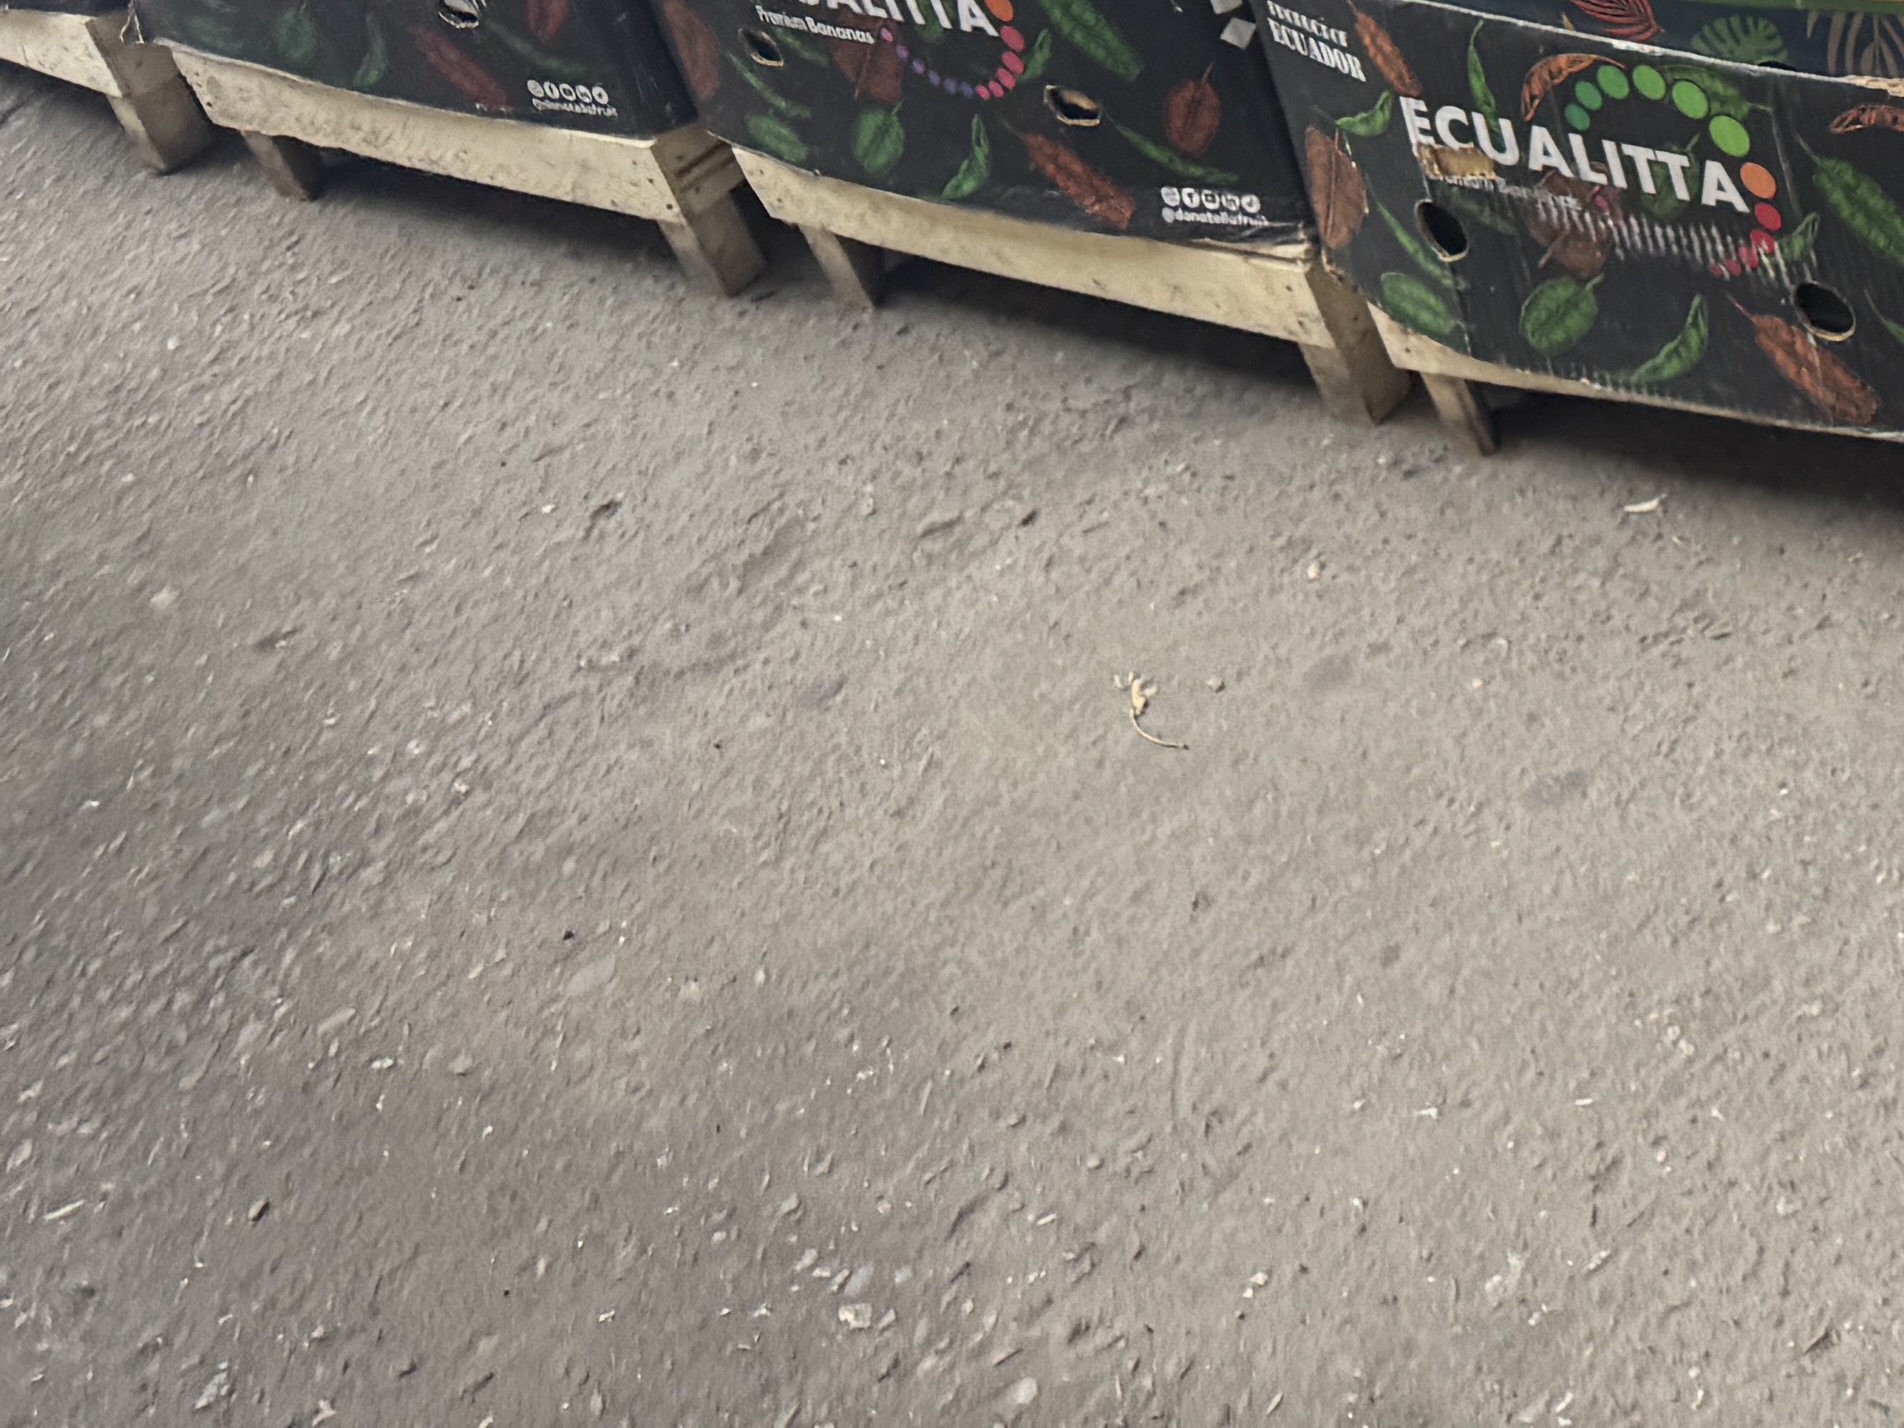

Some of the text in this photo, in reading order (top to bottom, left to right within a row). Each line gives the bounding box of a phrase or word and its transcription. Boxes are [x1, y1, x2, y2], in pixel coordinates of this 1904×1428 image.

[805, 16, 875, 45] Bananas
[1267, 17, 1367, 82] ECUADOR
[1399, 95, 1750, 214] ECUALITTA
